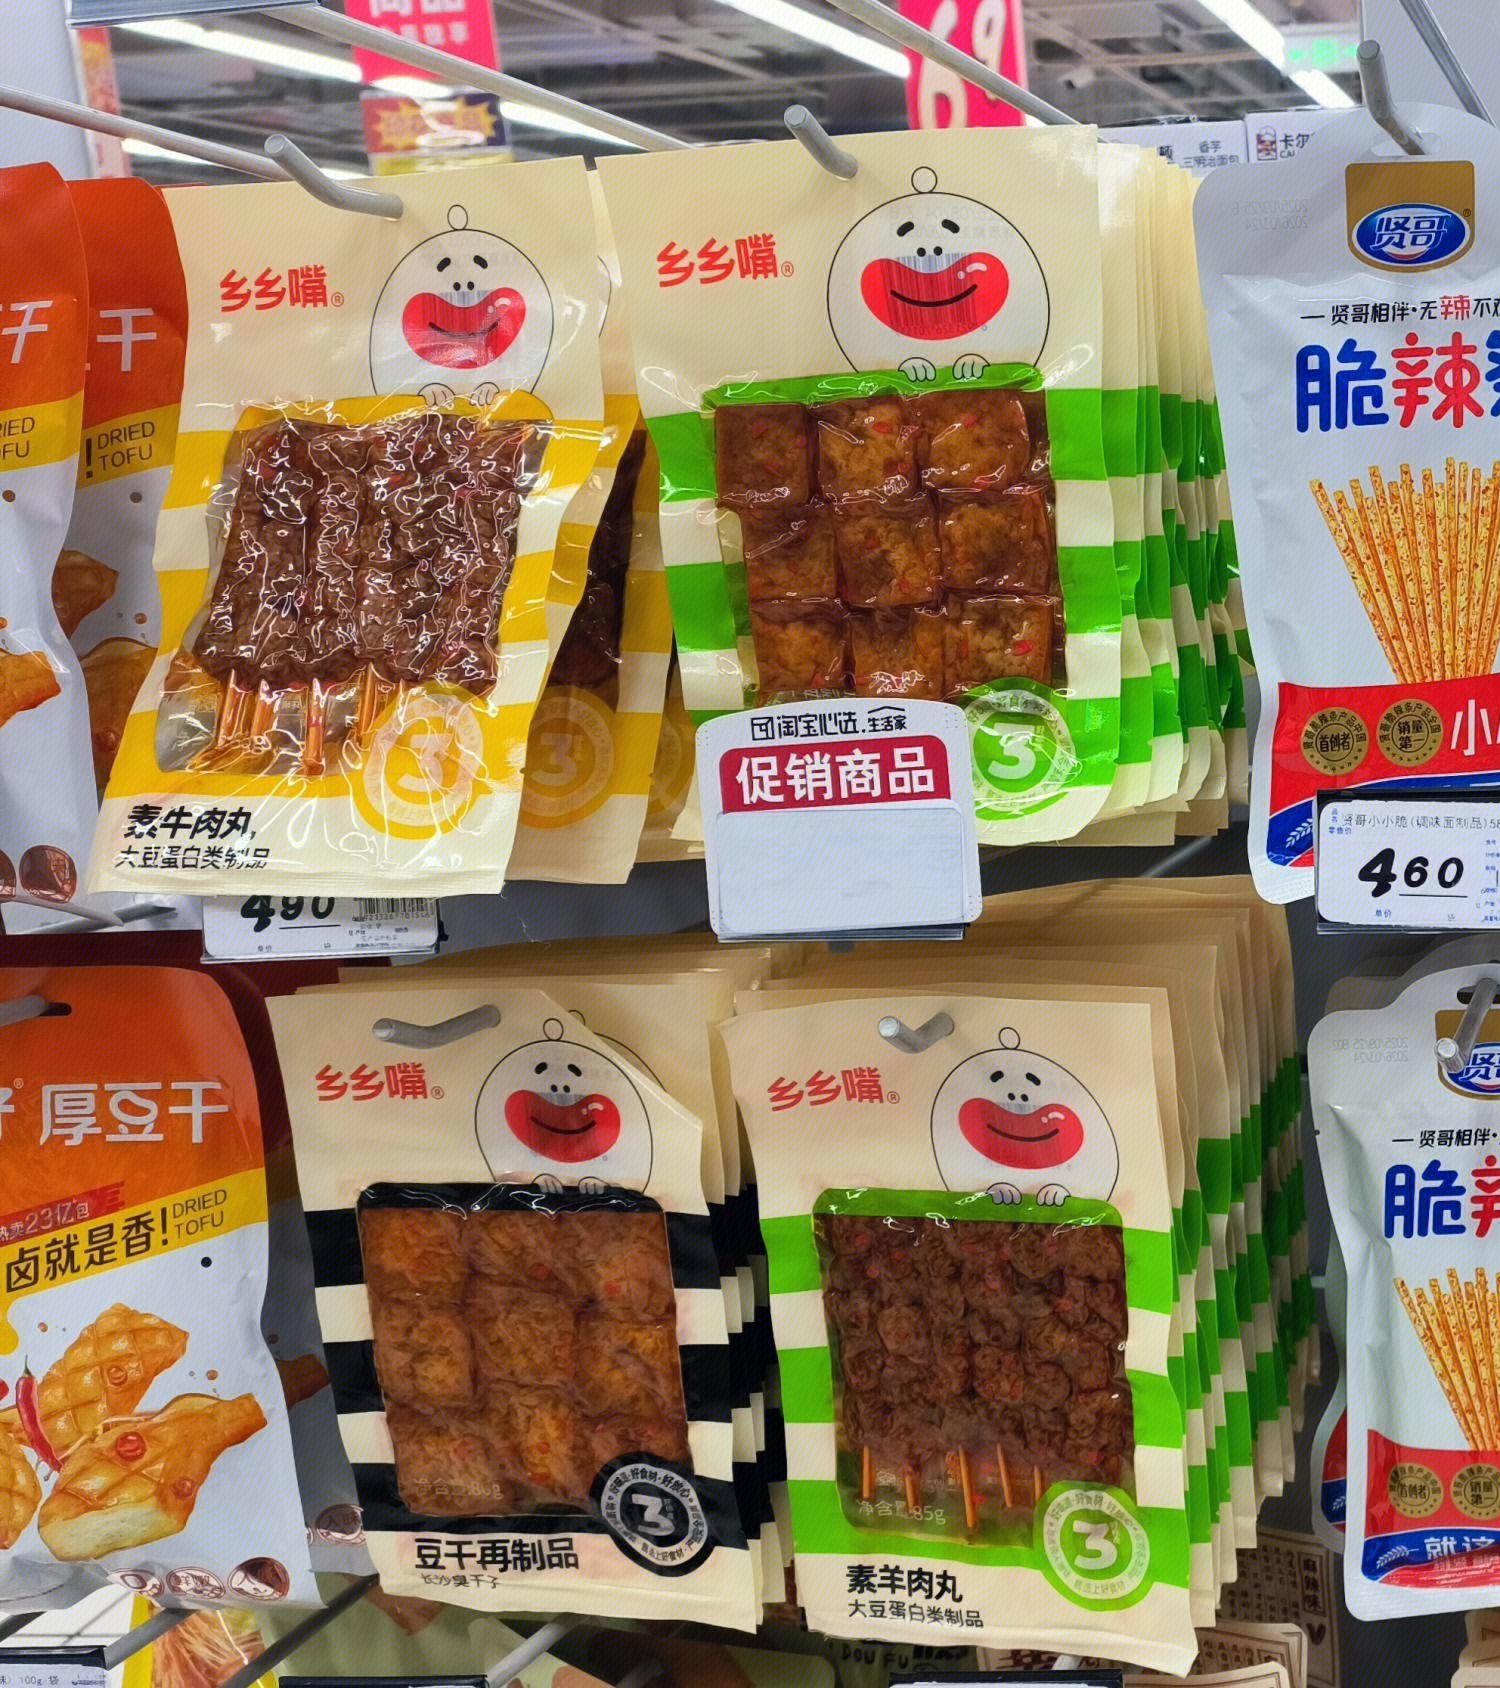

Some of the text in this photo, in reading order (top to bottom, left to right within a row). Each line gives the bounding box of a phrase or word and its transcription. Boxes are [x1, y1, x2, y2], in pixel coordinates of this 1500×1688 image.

[1280, 133, 1314, 149] 卡尔
[1369, 213, 1451, 250] 贤哥
[656, 233, 779, 287] 乡乡嘴
[220, 265, 328, 312] 乡乡嘴
[97, 308, 157, 371] 干
[97, 421, 155, 450] DRIED
[100, 444, 152, 472] TOFU
[735, 745, 935, 804] 促销商品
[124, 804, 256, 839] 素牛肉丸
[1358, 847, 1465, 898] 460
[315, 1062, 428, 1101] 乡乡嘴
[767, 1066, 884, 1112] 乡乡嘴
[40, 1081, 229, 1146] 厚豆干
[172, 1189, 227, 1219] DRIED
[174, 1210, 224, 1239] TOFU
[415, 1537, 579, 1572] 豆干再制品
[846, 1564, 962, 1602] 素羊肉丸
[847, 1600, 984, 1630] 大豆蛋白类制品
